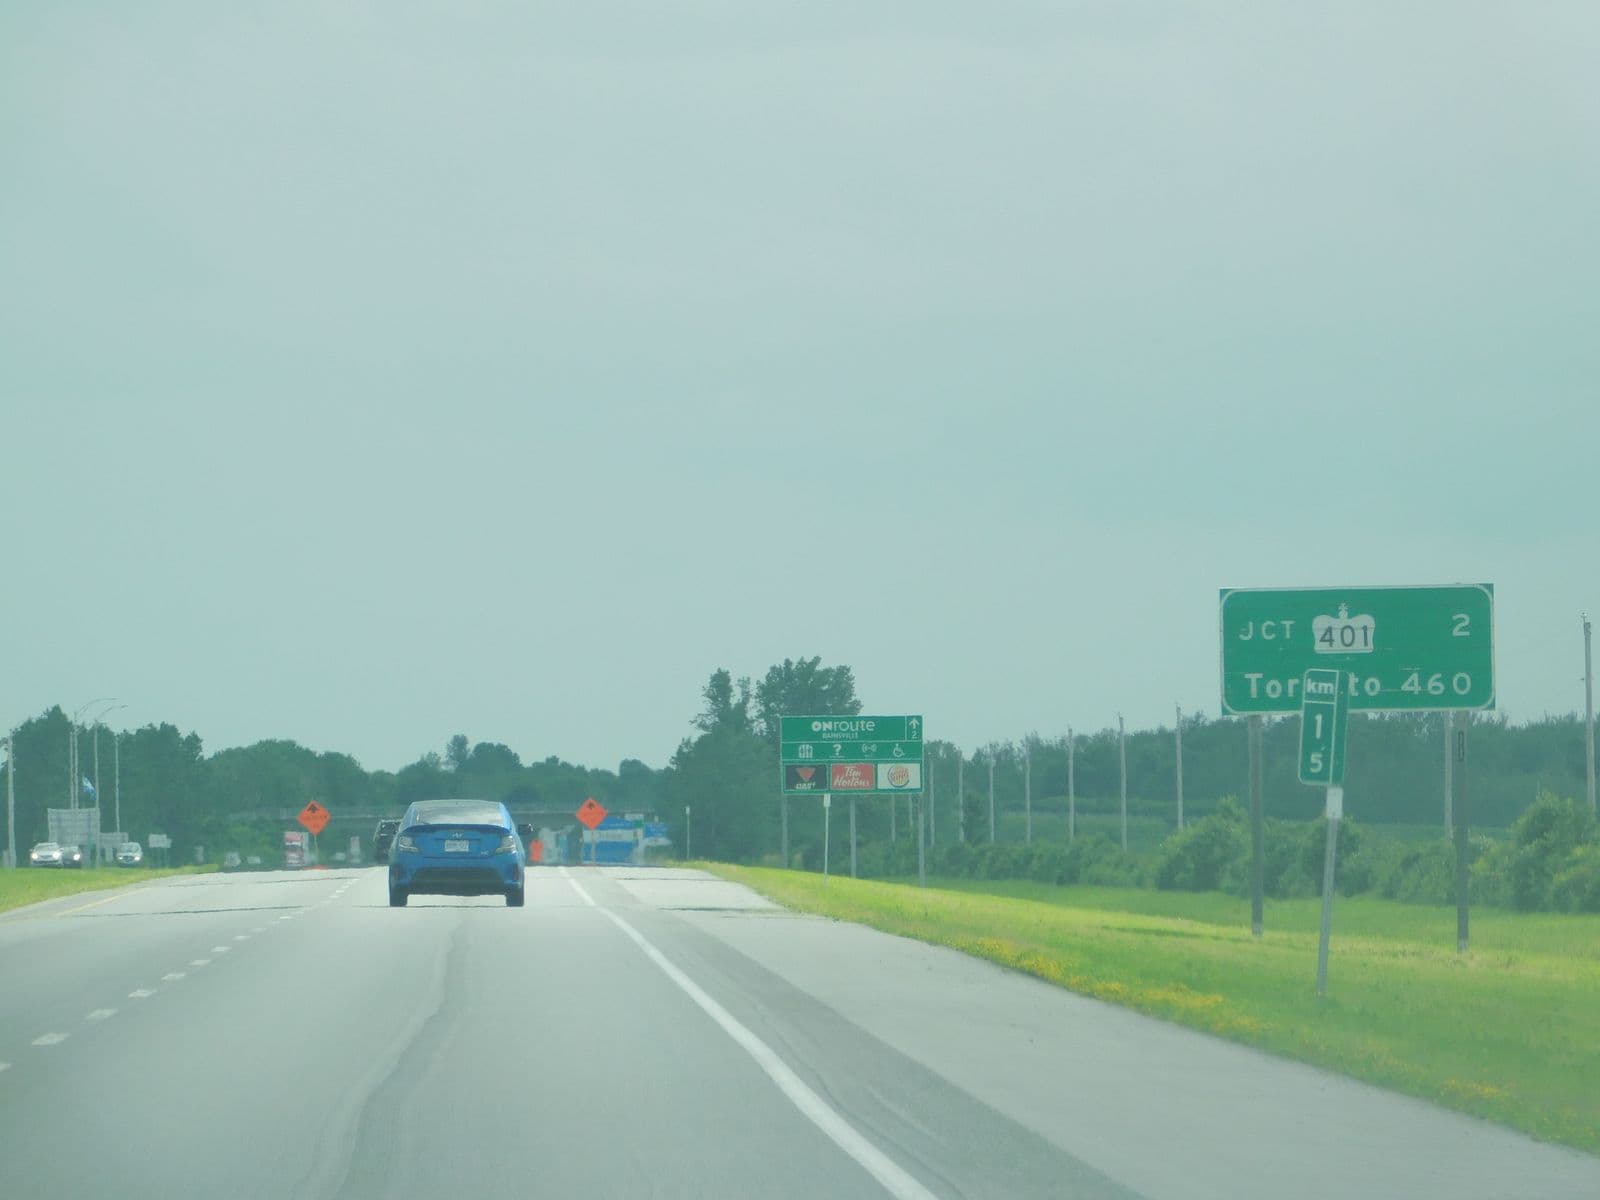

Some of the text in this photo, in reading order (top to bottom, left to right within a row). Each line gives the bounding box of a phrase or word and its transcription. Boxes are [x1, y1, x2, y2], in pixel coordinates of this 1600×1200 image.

[1238, 613, 1471, 648] JCT 401 2
[1244, 672, 1472, 699] Torto 460
[1306, 678, 1334, 695] km
[911, 730, 919, 740] 2
[844, 765, 862, 778] Tim
[833, 776, 870, 788] Hortons
